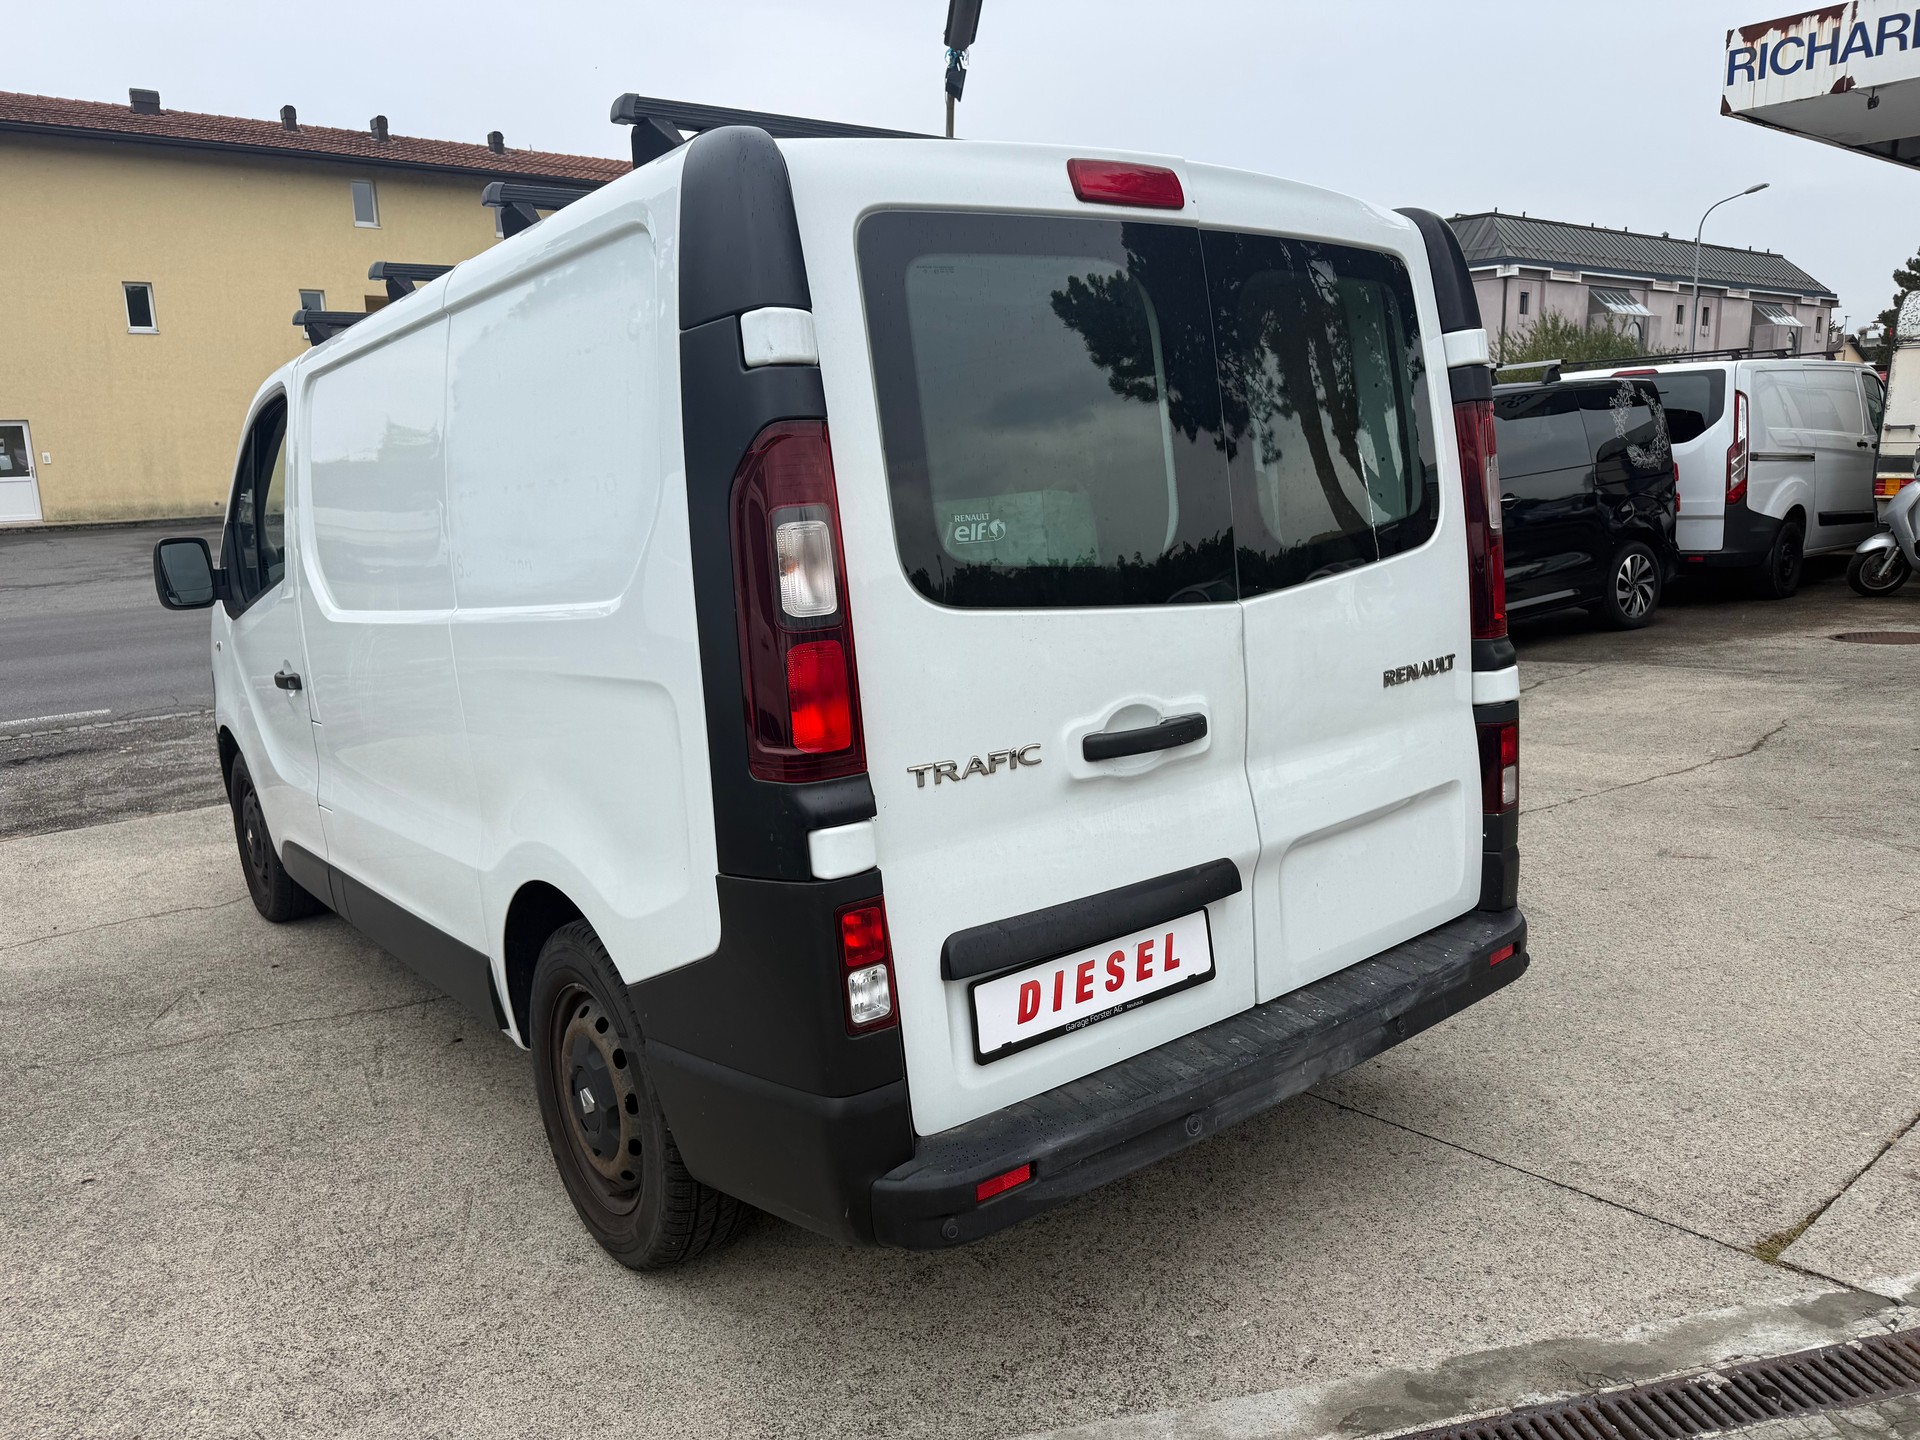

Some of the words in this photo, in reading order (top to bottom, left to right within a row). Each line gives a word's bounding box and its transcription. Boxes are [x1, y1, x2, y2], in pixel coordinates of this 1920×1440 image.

[1727, 9, 1920, 86] RICHAR
[954, 513, 990, 522] RENAULT
[954, 522, 987, 541] elf
[1383, 653, 1456, 688] RENAULT
[907, 743, 1042, 788] TRAFIC
[1017, 932, 1181, 1025] DIESEL
[1065, 1018, 1090, 1032] Garage
[1090, 1009, 1113, 1022] Forster
[1113, 1004, 1123, 1014] AG
